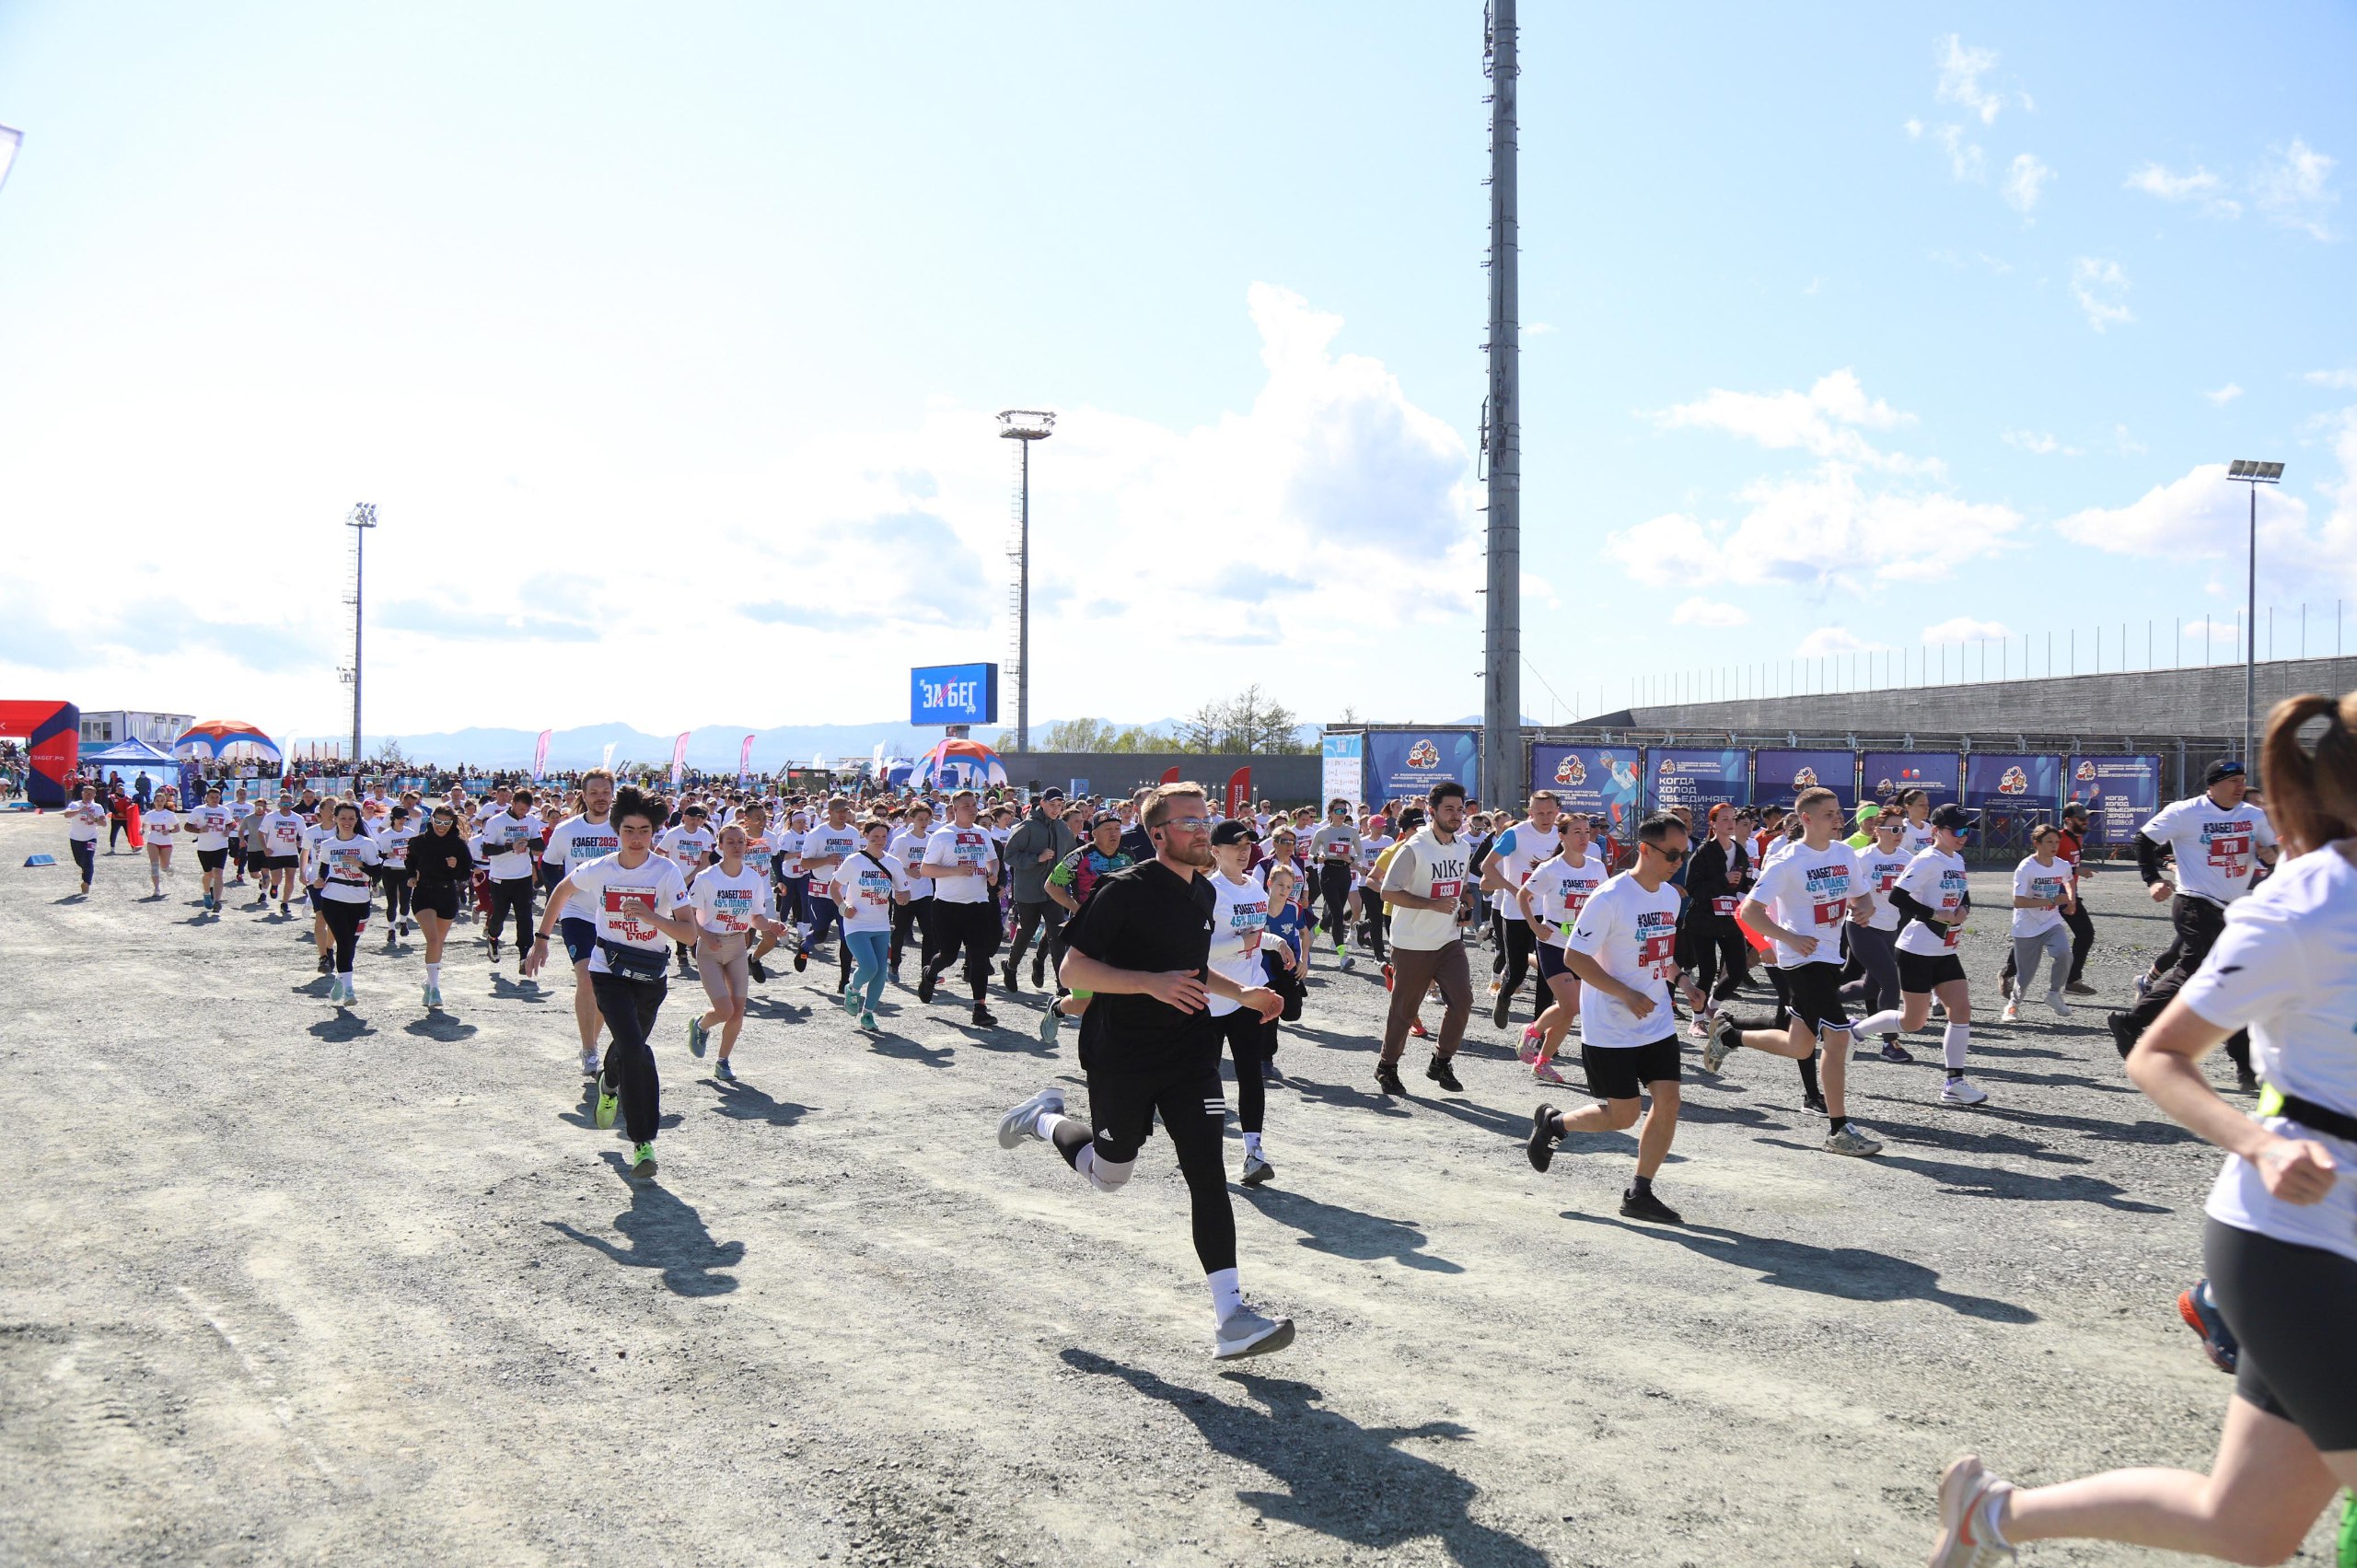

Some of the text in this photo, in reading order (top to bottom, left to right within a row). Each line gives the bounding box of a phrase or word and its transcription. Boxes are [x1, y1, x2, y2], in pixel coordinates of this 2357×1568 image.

[1659, 777, 1695, 785] КОГДА
[1659, 786, 1697, 795] ХОЛОД
[1659, 795, 1735, 803] ОБЪЕДИНЯЕТ
[2202, 820, 2254, 833] #ЗАБЕГ2025
[572, 836, 619, 847] #ЗАБЕГ2025
[2222, 840, 2238, 854] 778
[1431, 859, 1464, 880] NIKE
[1806, 865, 1850, 881] #ЗАБЕГ2025
[858, 877, 870, 886] 45%
[1562, 879, 1599, 889] #ЗАБЕГ2025
[1805, 878, 1823, 892] 45%
[1939, 879, 1956, 889] 45%
[717, 889, 753, 899] #ЗАБЕГ2025
[1439, 884, 1455, 897] 1333
[714, 899, 727, 908] 45%
[1230, 914, 1246, 927] 45%
[1638, 911, 1676, 928] #ЗАБЕГ2025
[1657, 939, 1669, 958] 744
